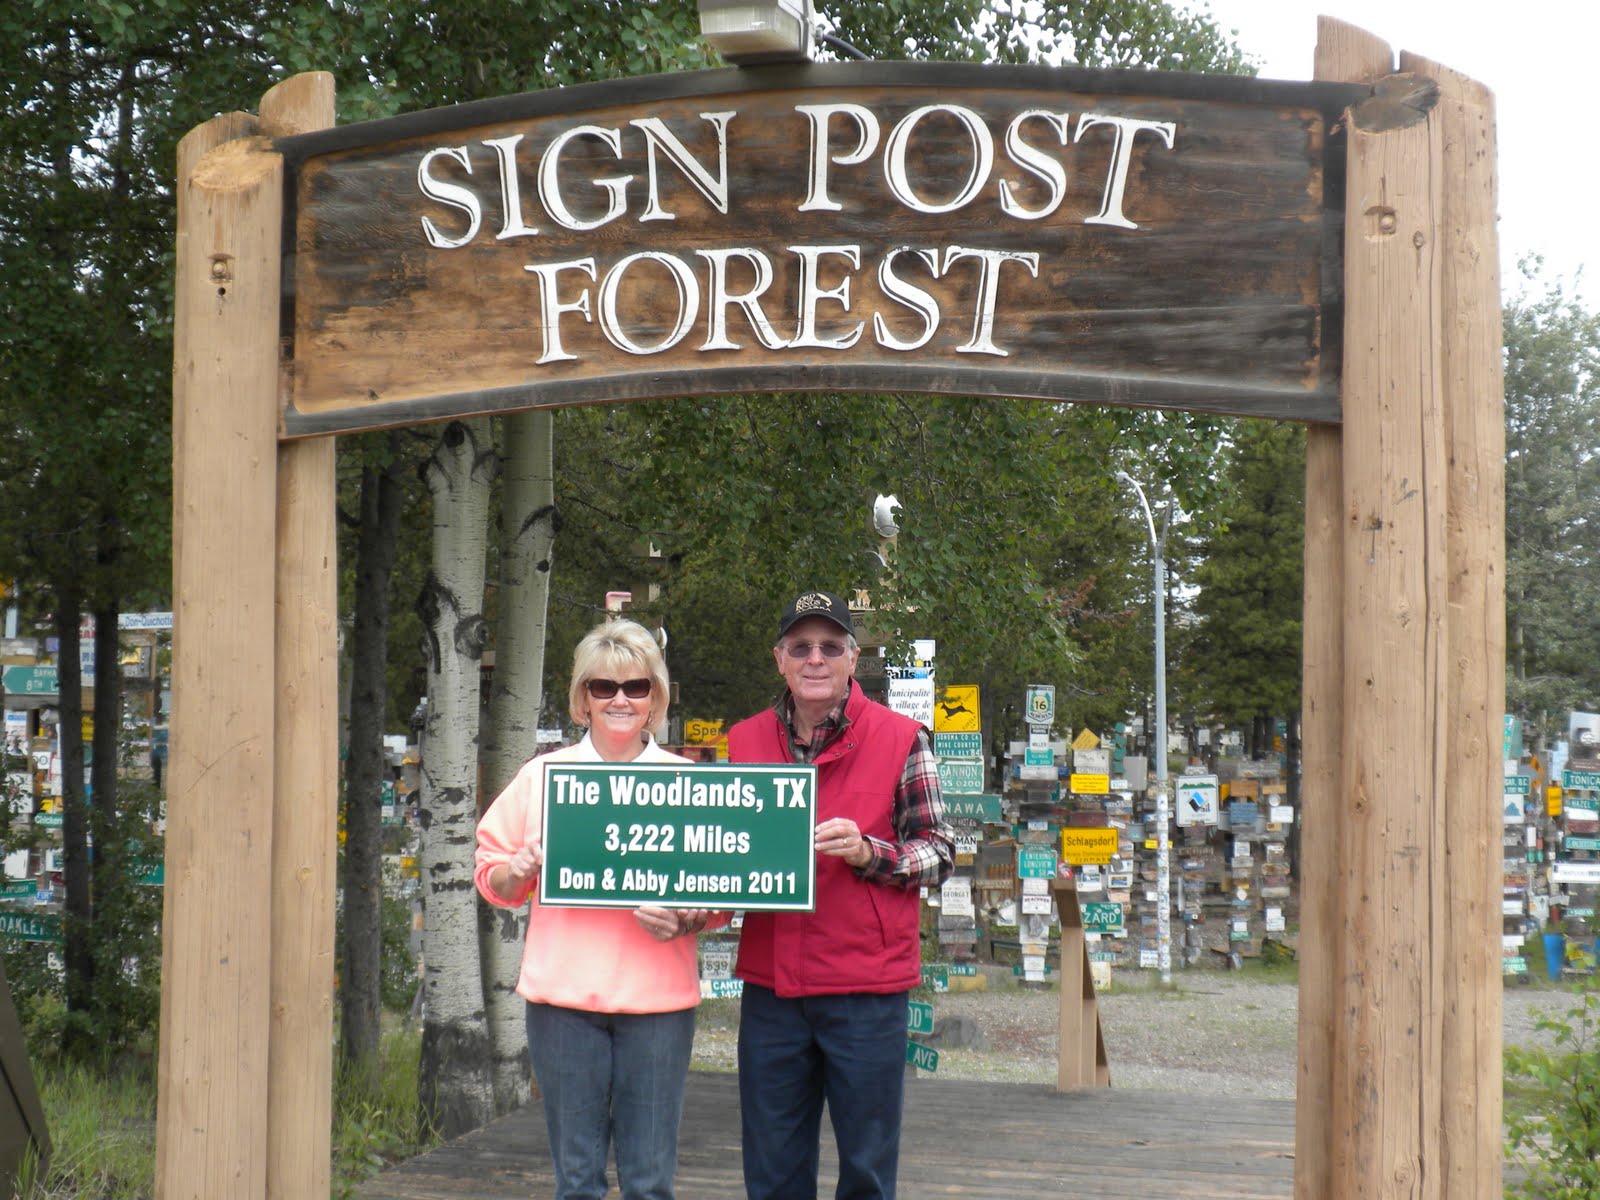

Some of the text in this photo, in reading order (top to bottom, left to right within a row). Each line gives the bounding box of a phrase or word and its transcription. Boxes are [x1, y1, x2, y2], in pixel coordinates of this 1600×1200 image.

[417, 102, 1176, 249] SIGN POST
[524, 244, 1040, 364] FOREST
[922, 700, 931, 709] de
[1035, 700, 1047, 710] 16
[553, 774, 807, 813] The Woodlands, TX
[604, 823, 751, 856] 3,222 Miles
[1066, 836, 1115, 849] Schlagsdorf
[559, 867, 796, 896] Don & Abby Jensen 2011
[913, 1047, 937, 1070] AVE
